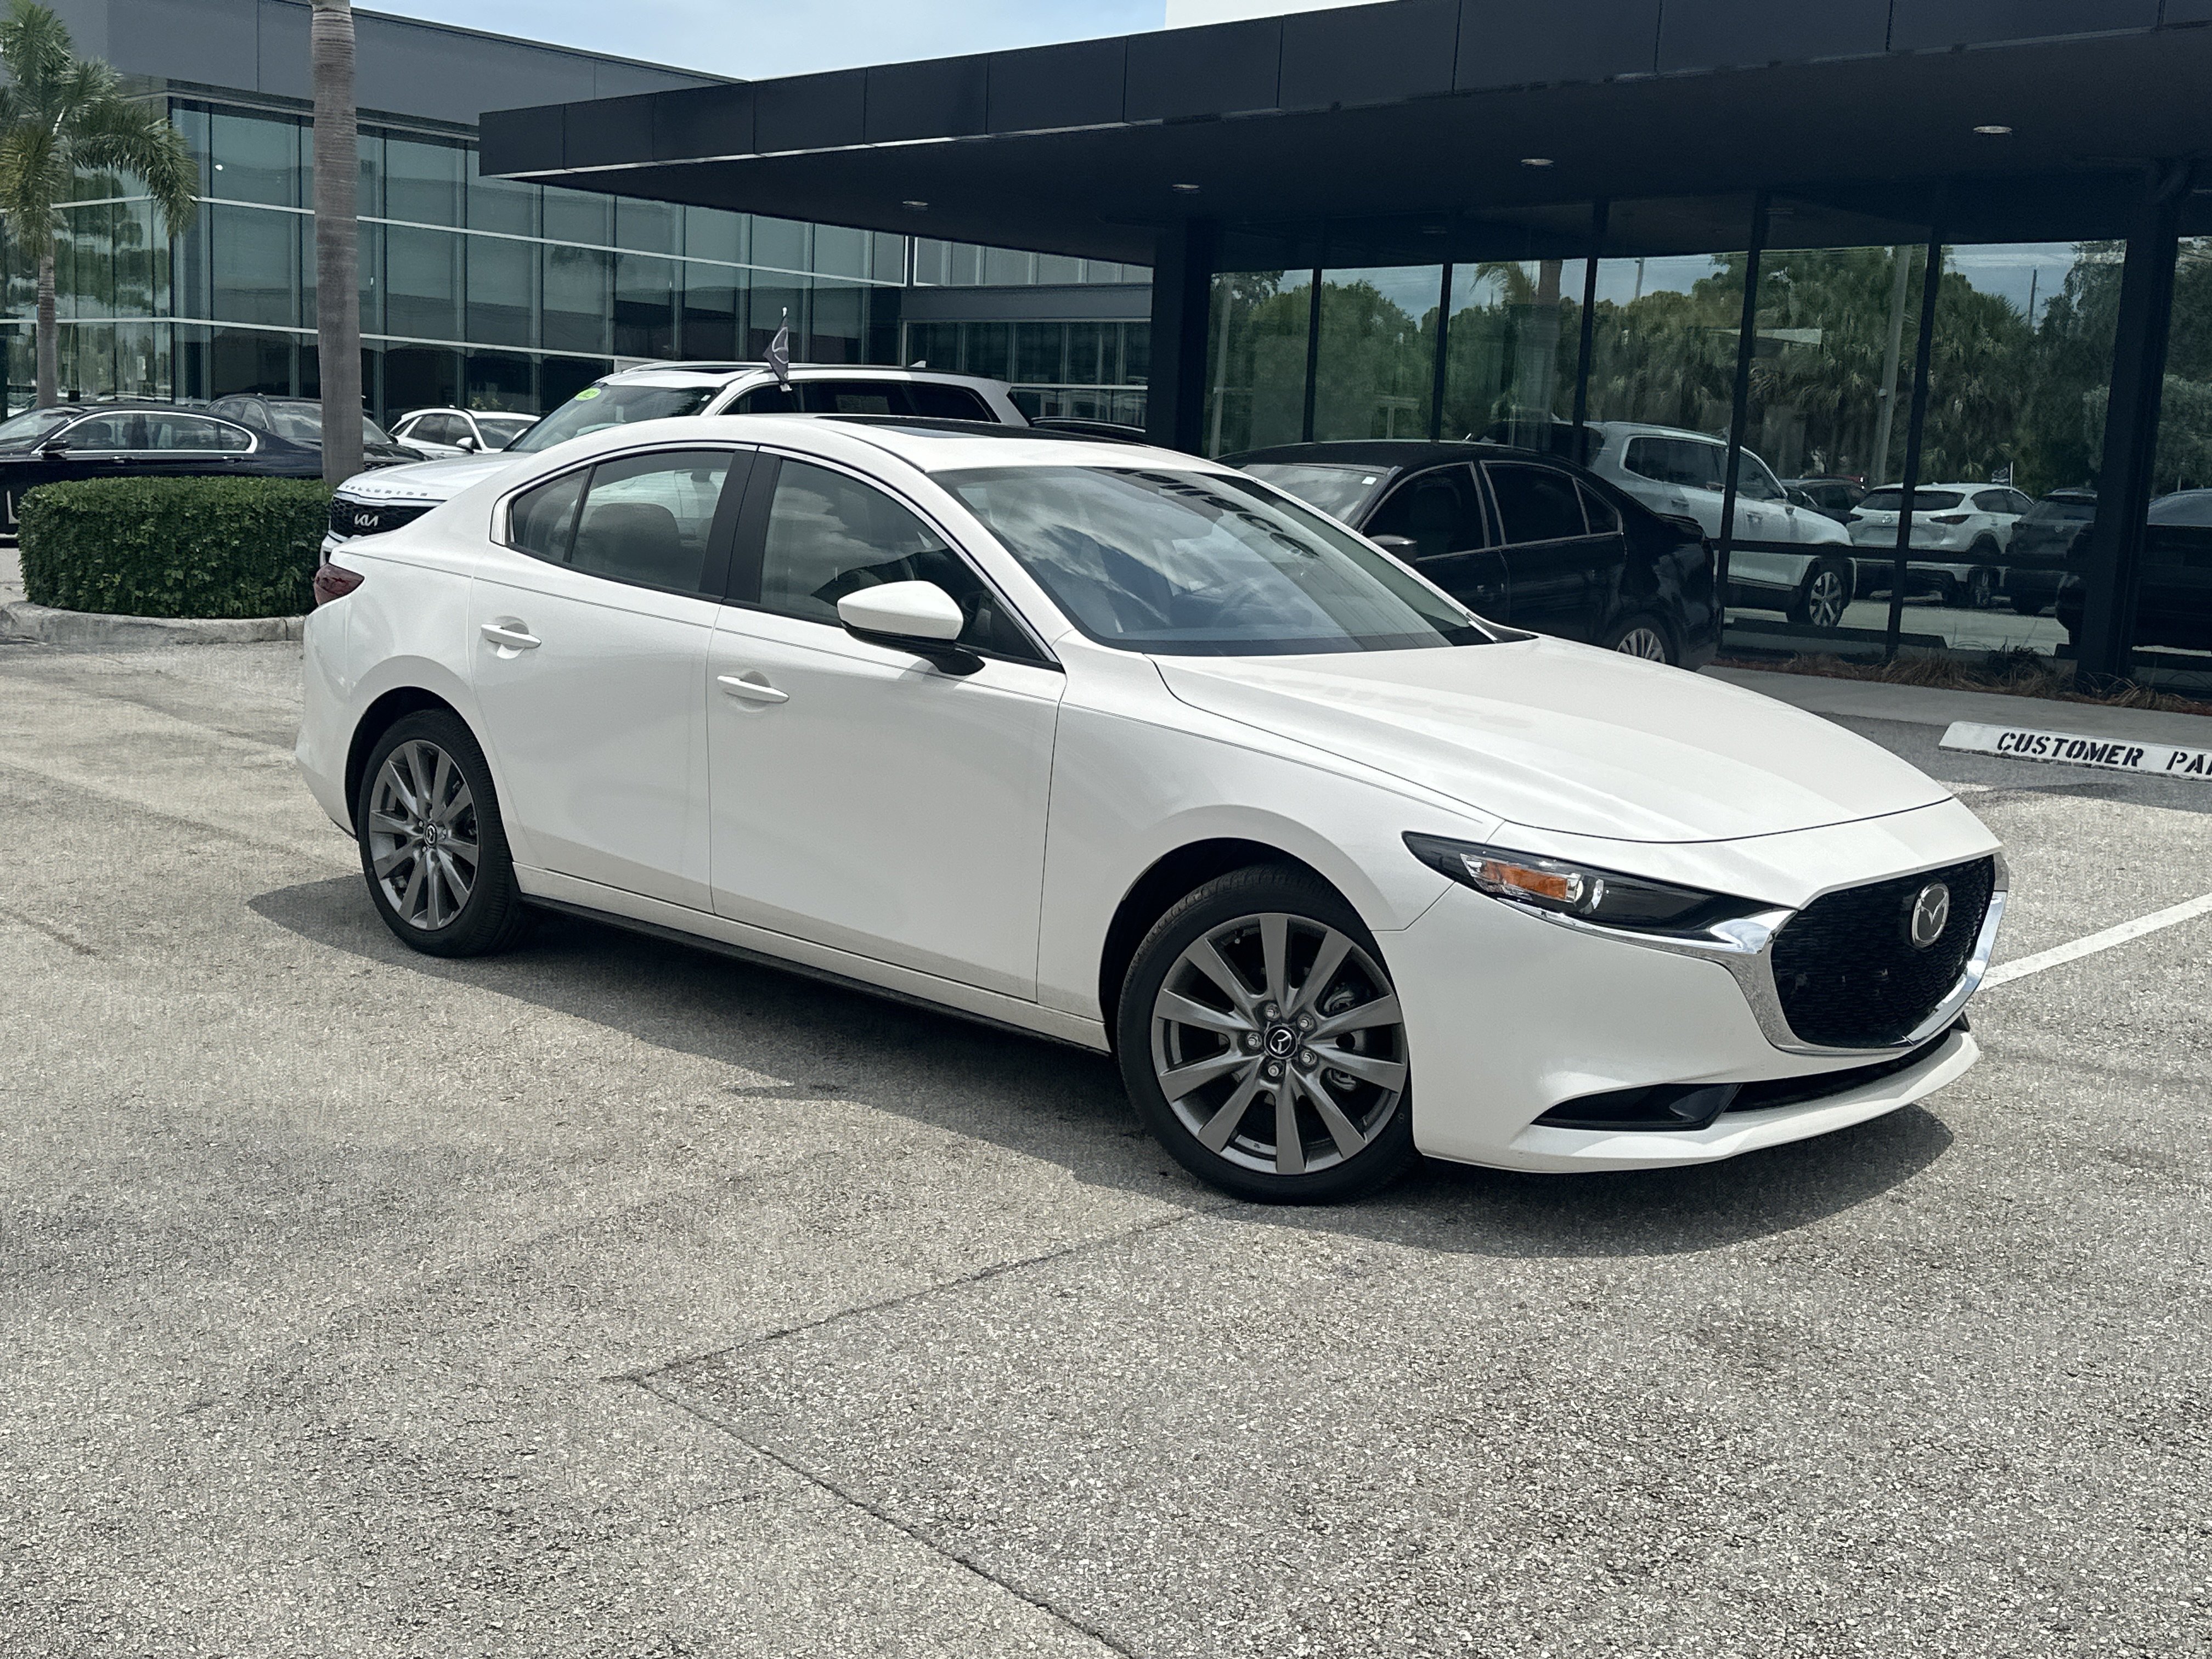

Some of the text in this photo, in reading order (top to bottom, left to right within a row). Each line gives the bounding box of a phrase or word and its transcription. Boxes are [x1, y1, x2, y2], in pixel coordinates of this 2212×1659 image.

[345, 485, 428, 497] TELLURIDE
[354, 513, 379, 527] KIA
[1997, 732, 2212, 775] CUSTOMER PA
